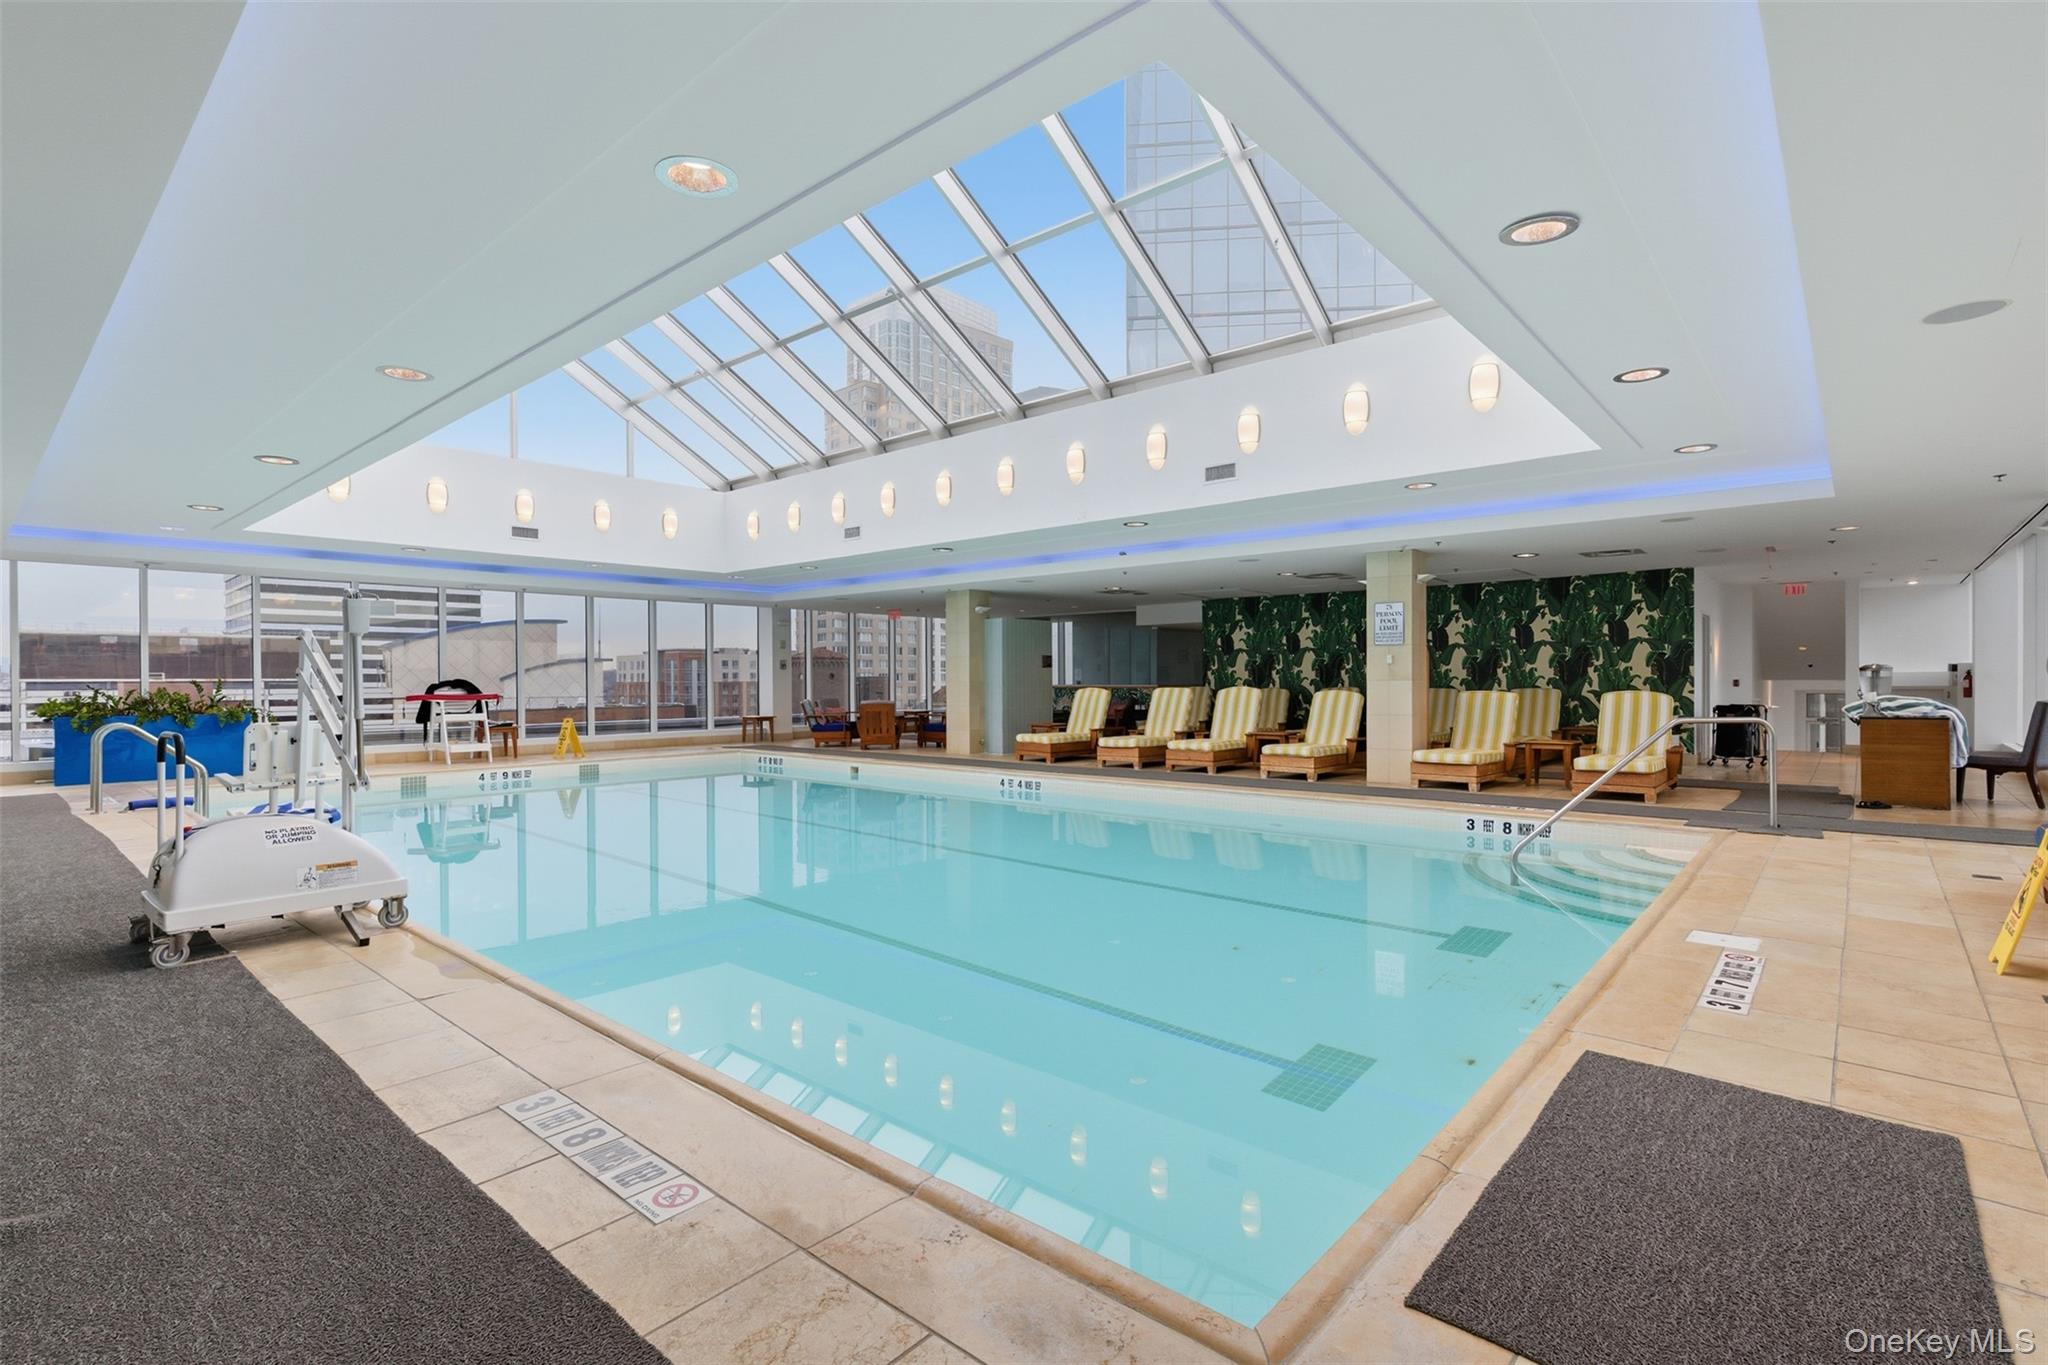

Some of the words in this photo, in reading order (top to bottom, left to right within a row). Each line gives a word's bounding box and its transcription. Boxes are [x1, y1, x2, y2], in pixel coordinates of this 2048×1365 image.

[1785, 585, 1807, 596] EXIT
[479, 773, 485, 781] 4
[502, 771, 509, 780] 9
[279, 825, 314, 833] PLAYING
[1466, 818, 1475, 831] 3
[1503, 822, 1512, 834] 8
[280, 829, 316, 839] JUMPING
[272, 835, 313, 845] ALLOWED
[1706, 1000, 1742, 1010] 3
[515, 1096, 556, 1113] 3
[534, 1108, 585, 1131] FEET
[562, 1127, 607, 1148] 8
[611, 1161, 668, 1189] DEEP
